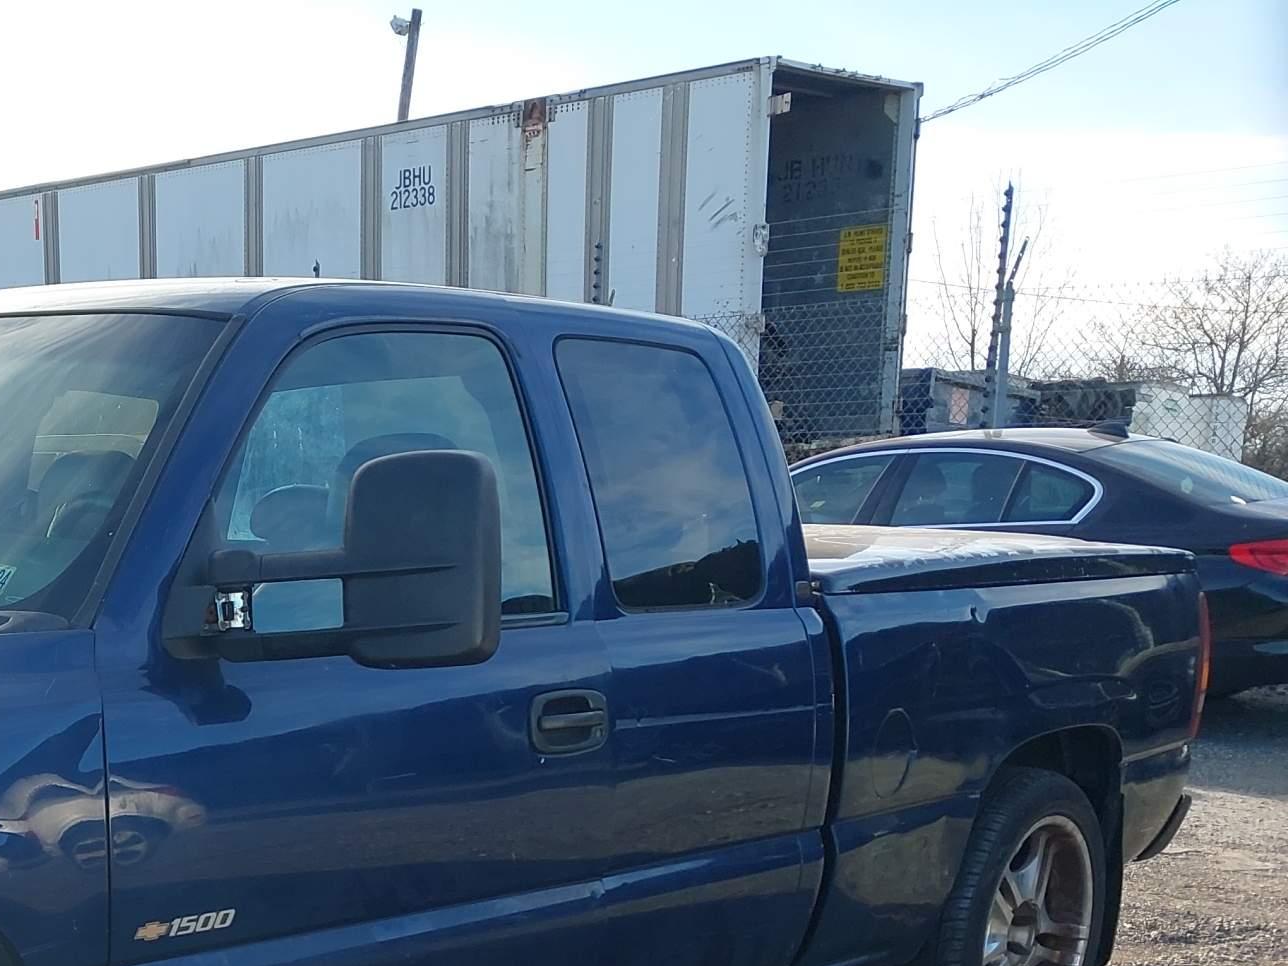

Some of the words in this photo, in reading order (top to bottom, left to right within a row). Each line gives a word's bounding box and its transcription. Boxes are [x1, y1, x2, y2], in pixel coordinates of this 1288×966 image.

[395, 165, 432, 190] JBHU
[390, 185, 436, 211] 212338
[169, 908, 236, 937] 1500
